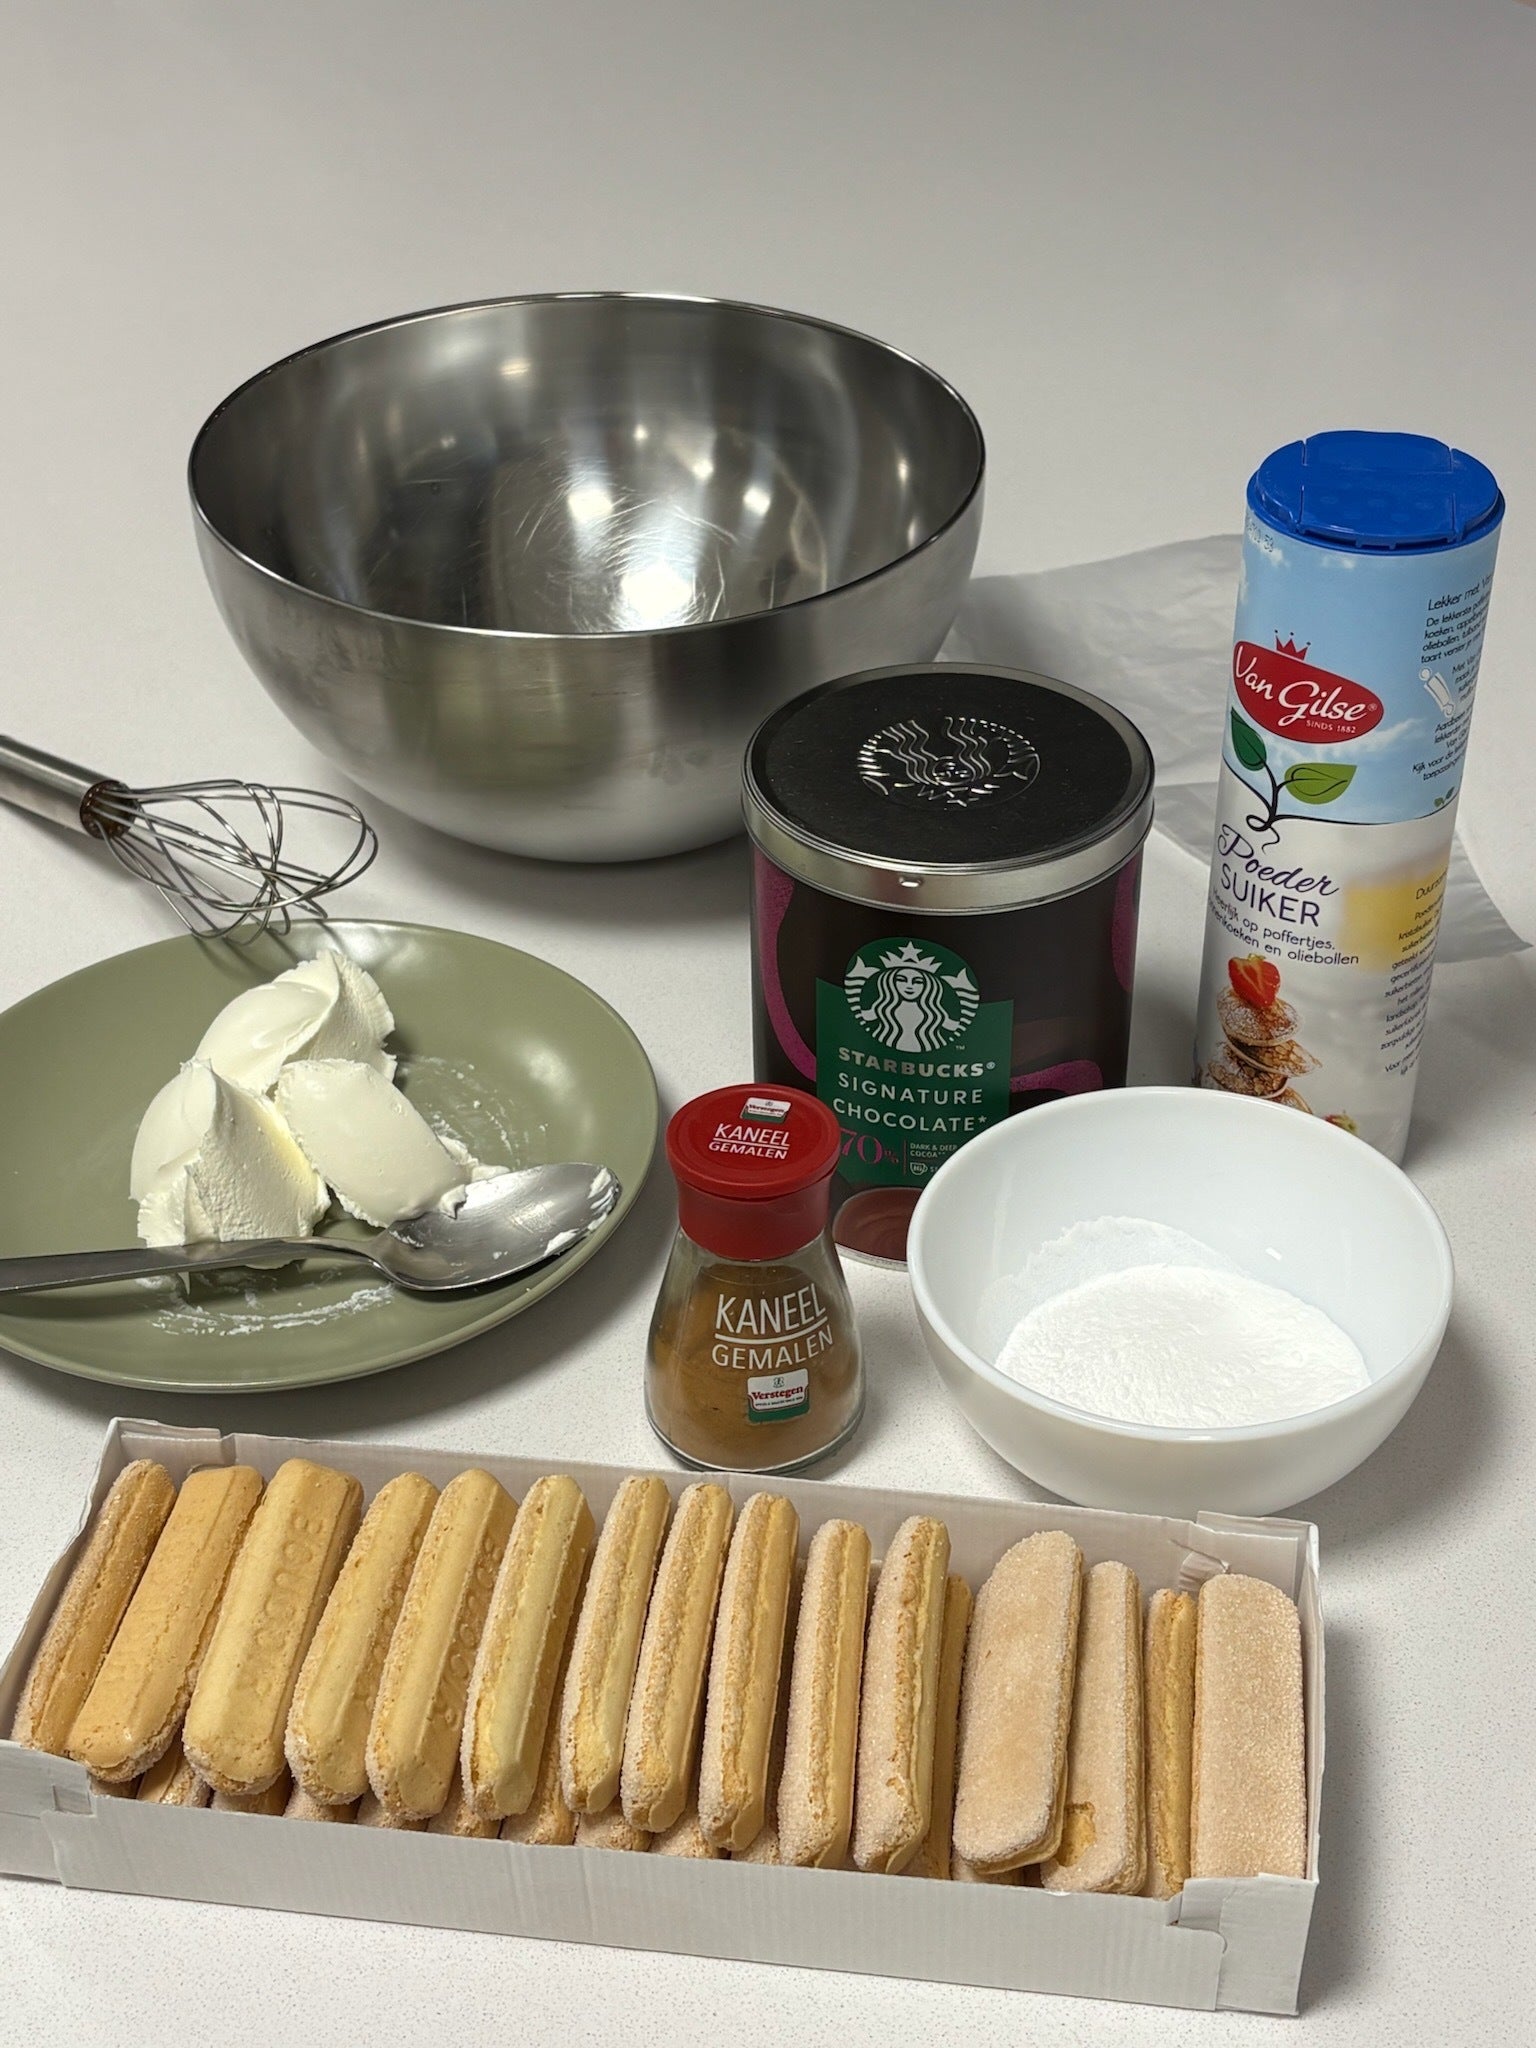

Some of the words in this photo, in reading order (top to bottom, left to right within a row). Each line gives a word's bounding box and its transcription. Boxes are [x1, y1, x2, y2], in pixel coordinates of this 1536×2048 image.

[1427, 594, 1462, 611] Lekker
[1421, 651, 1442, 663] taart
[1235, 646, 1274, 701] Van
[1306, 719, 1334, 732] SINDS
[1337, 724, 1357, 734] 1882
[1218, 823, 1340, 896] Poeder
[1221, 863, 1320, 927] SUIKER
[1243, 918, 1258, 932] op
[1264, 943, 1282, 957] en
[1287, 950, 1360, 966] oliebollen
[838, 1072, 983, 1105] SIGNATURE
[714, 1123, 791, 1147] KANEEL
[708, 1141, 788, 1160] GEMALEN
[715, 1283, 827, 1335] KANEEL
[711, 1324, 834, 1370] GEMALEN
[751, 1386, 804, 1400] Verstegen
